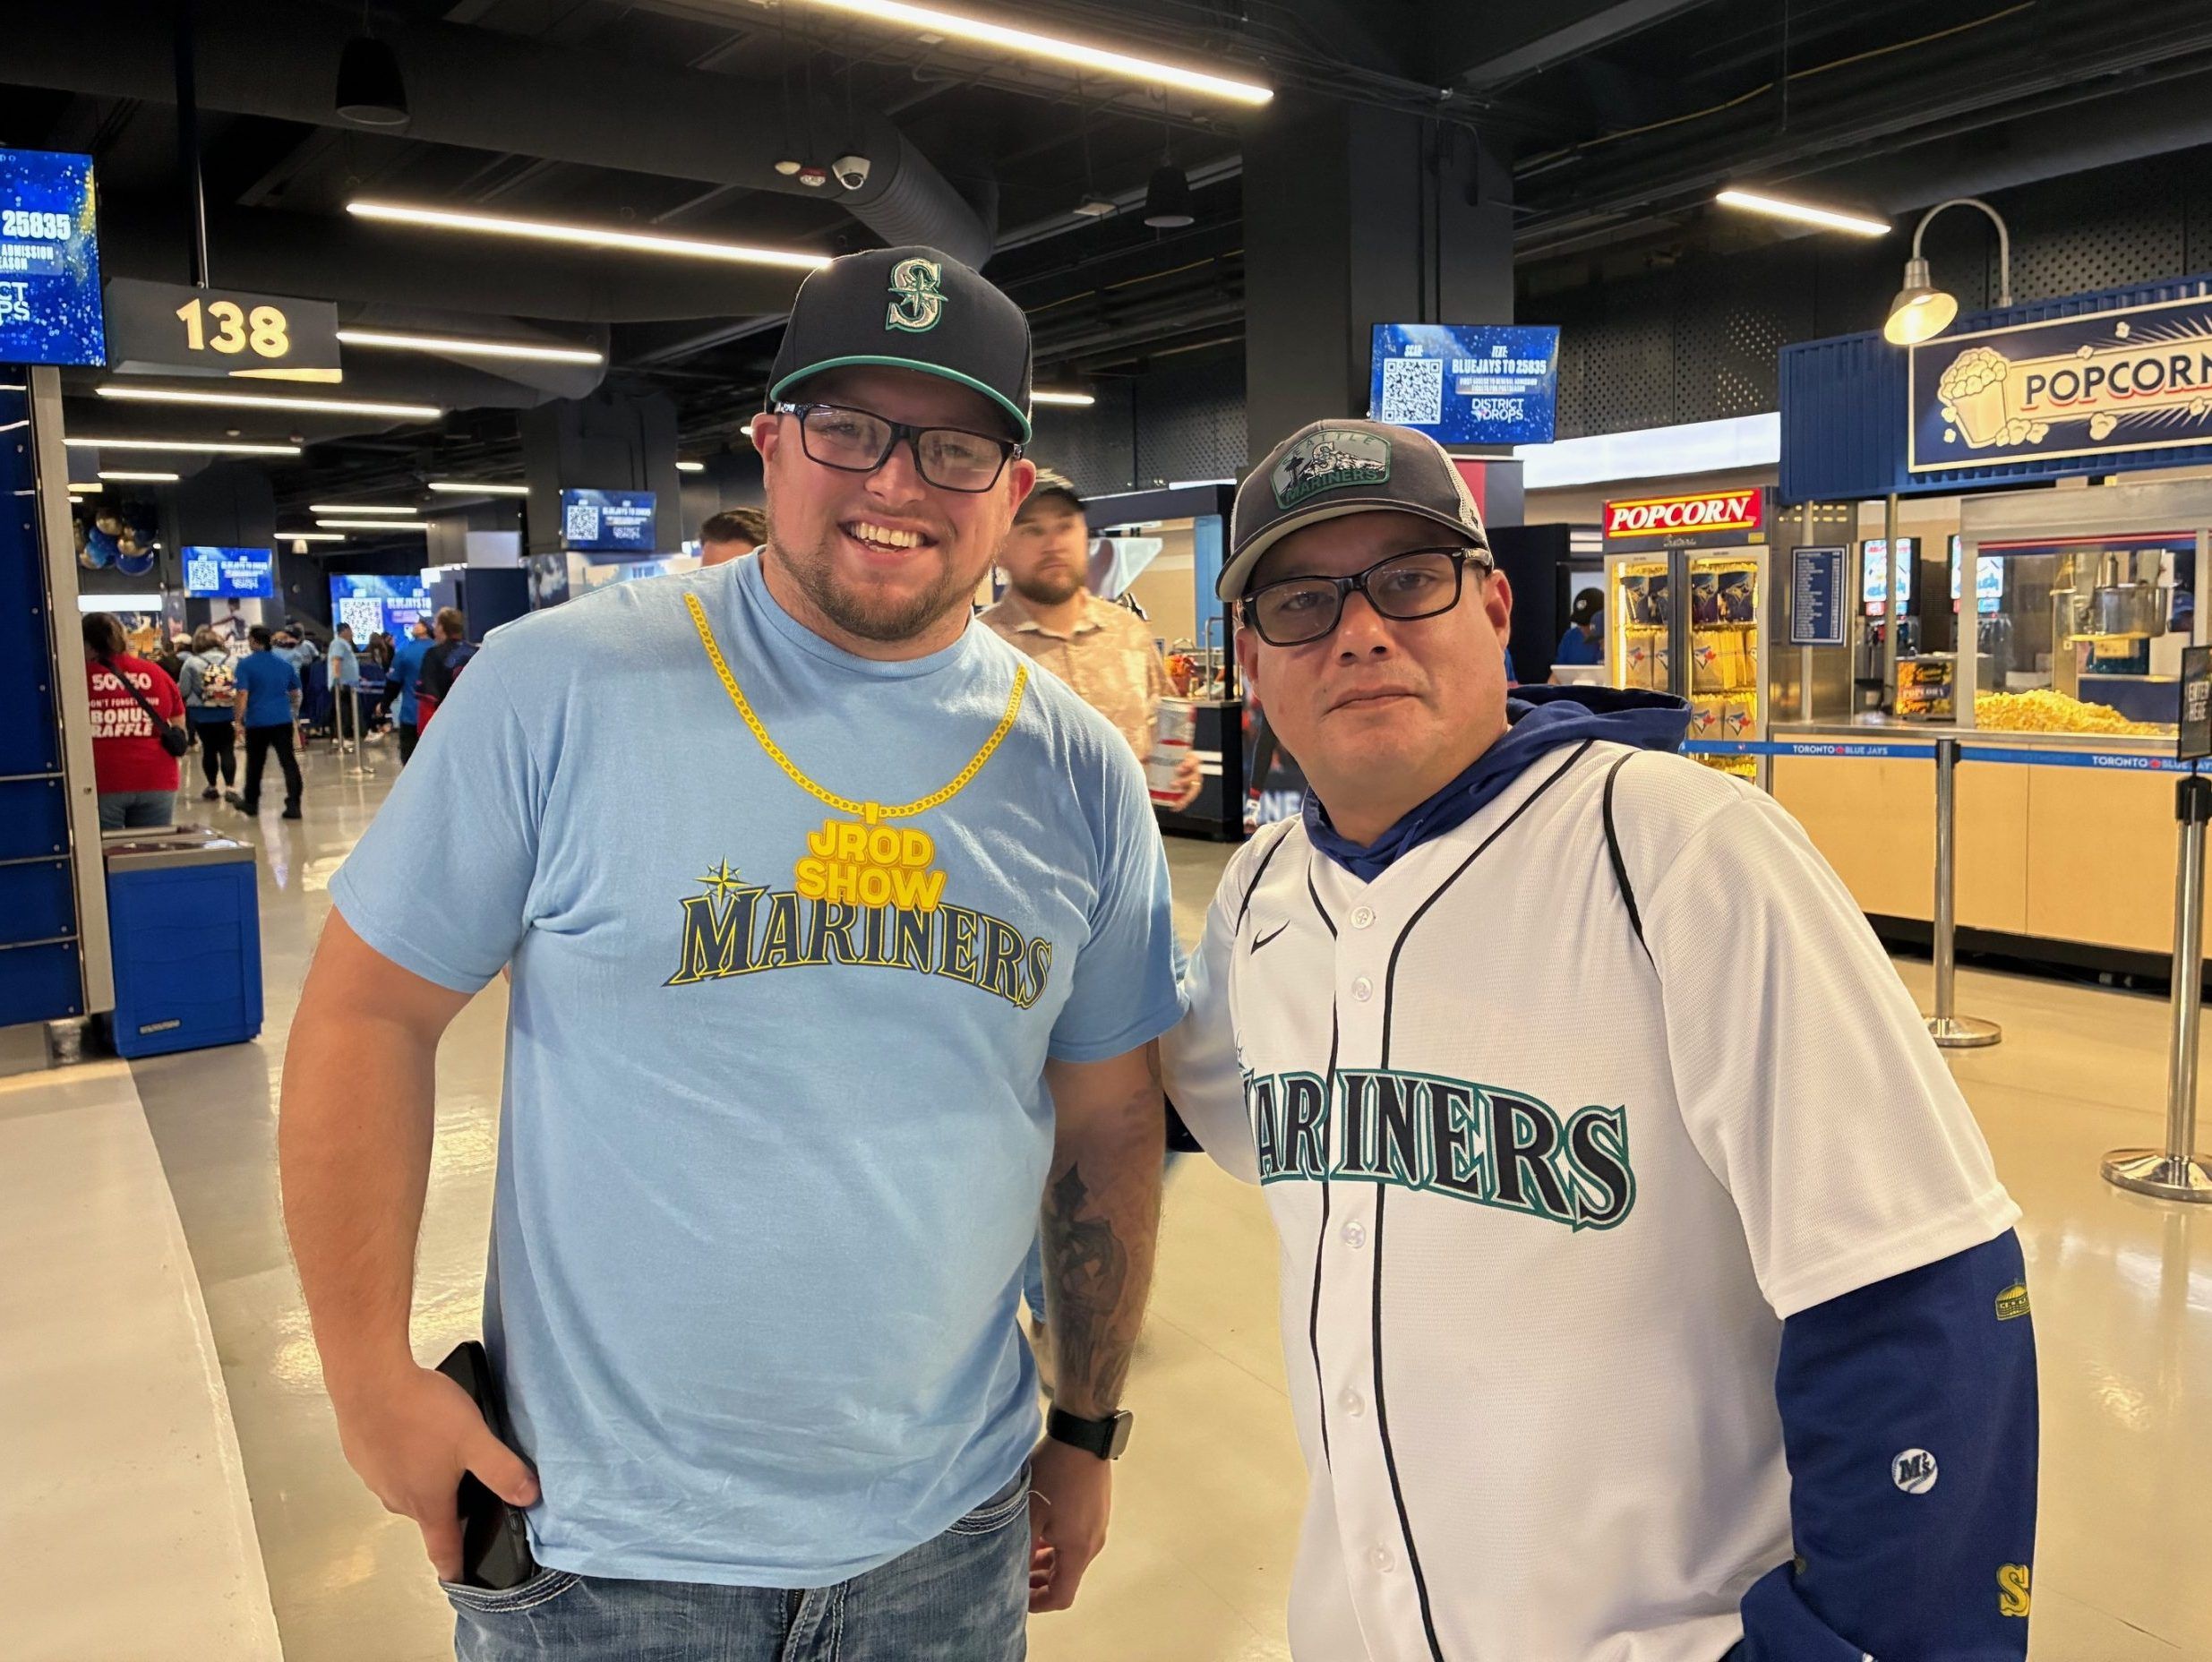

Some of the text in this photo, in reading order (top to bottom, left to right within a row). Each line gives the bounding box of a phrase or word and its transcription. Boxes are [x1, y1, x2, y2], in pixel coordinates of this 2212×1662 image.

[2, 210, 71, 240] 25835
[0, 256, 28, 270] ASON
[176, 298, 289, 358] 138
[1452, 359, 1502, 374] BLUEJAYS
[1503, 359, 1515, 374] TO
[1471, 398, 1524, 410] DISTRICT
[1482, 409, 1524, 424] DROPS
[1285, 469, 1377, 501] MARINERS
[1609, 497, 1751, 531] POPCORN
[90, 698, 109, 708] ON'T
[2189, 681, 2209, 702] ENTER
[91, 723, 154, 738] RAFFLE
[1793, 744, 1888, 755] TORONTO BLUE JAYS
[2092, 756, 2148, 767] TORONTO
[808, 820, 934, 869] JROD
[794, 857, 947, 913] SHOW
[662, 885, 1052, 1010] MARINERS
[1242, 1068, 1636, 1234] ARINERS
[1996, 1563, 2030, 1617] S
